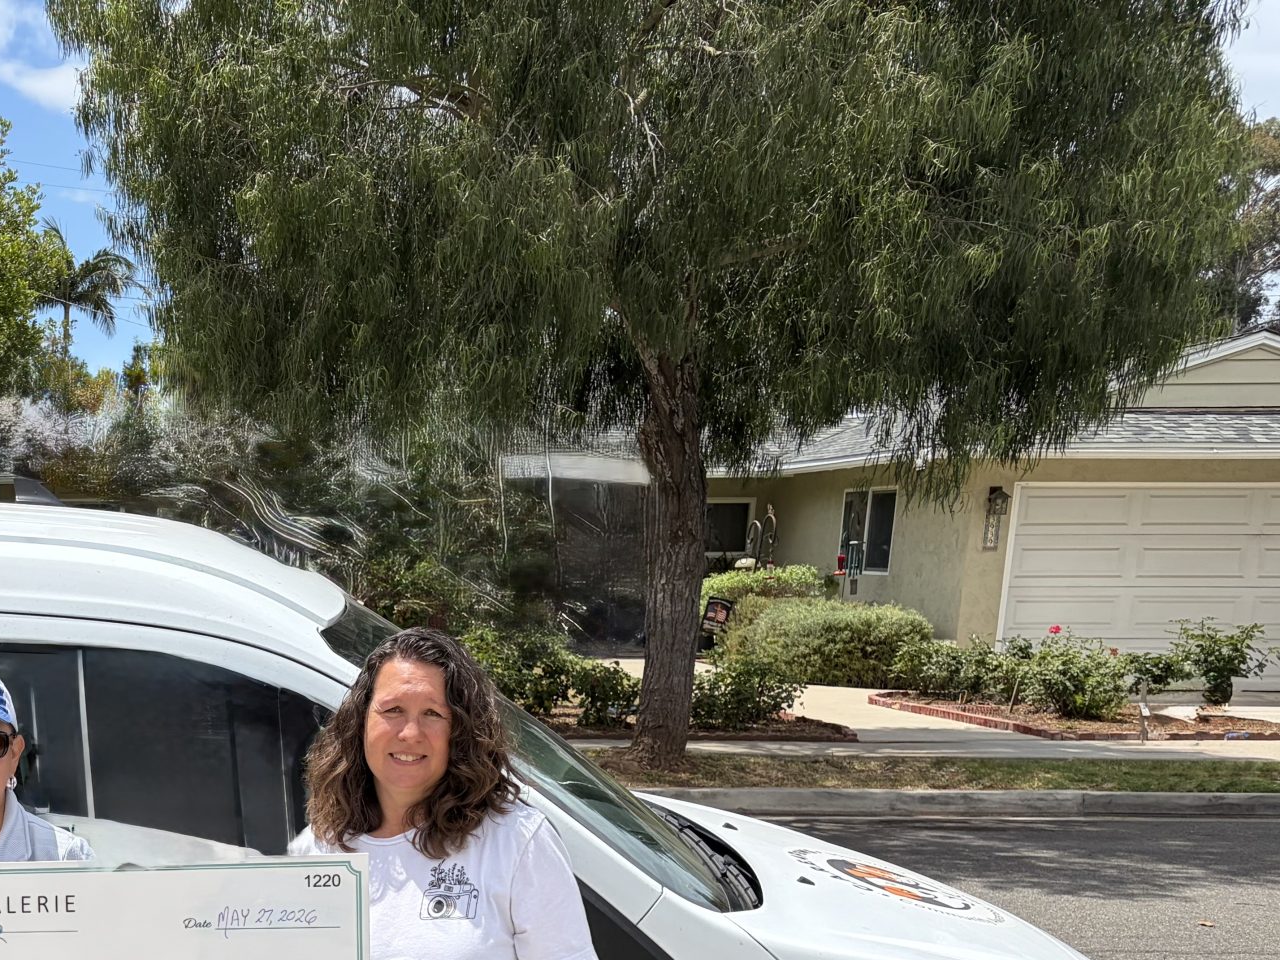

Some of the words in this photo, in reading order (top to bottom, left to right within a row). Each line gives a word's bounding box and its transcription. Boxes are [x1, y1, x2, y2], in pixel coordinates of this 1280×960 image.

[304, 873, 341, 888] 1220
[183, 917, 213, 930] Date
[217, 905, 250, 939] MAY
[277, 908, 318, 925] 2026
